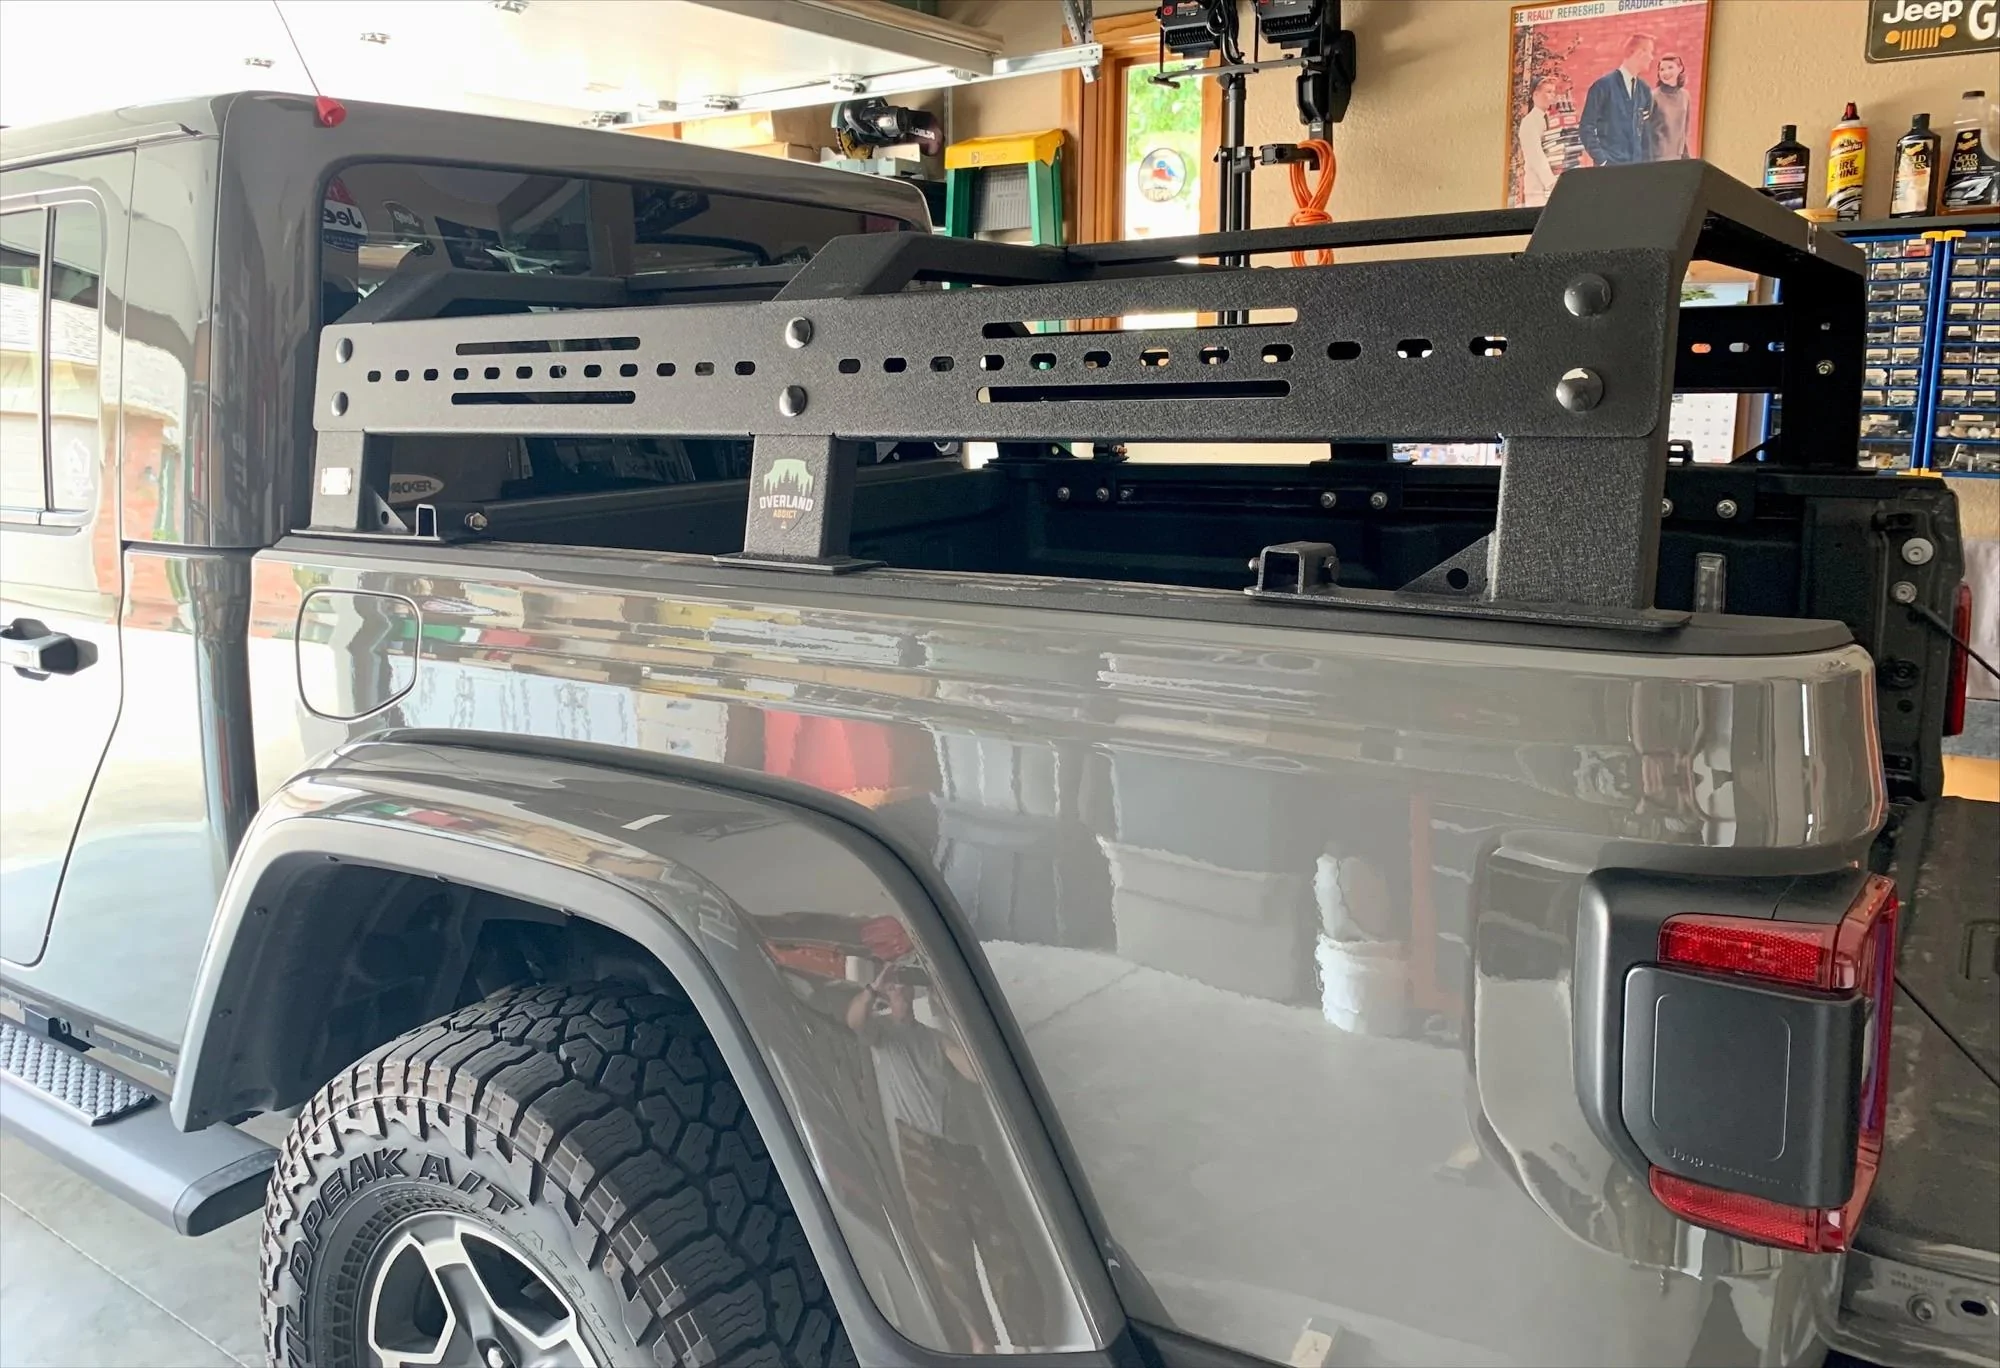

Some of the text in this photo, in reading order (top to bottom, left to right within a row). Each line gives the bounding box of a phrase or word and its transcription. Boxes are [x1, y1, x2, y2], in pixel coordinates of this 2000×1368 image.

[1513, 11, 1524, 24] BE
[1527, 9, 1554, 22] REALLY
[1557, 3, 1605, 19] REFRESHED
[1882, 0, 2000, 41] Jeep G
[1953, 153, 1978, 162] GOLD
[759, 495, 814, 512] OVERLAND
[772, 509, 798, 519] ADDICT
